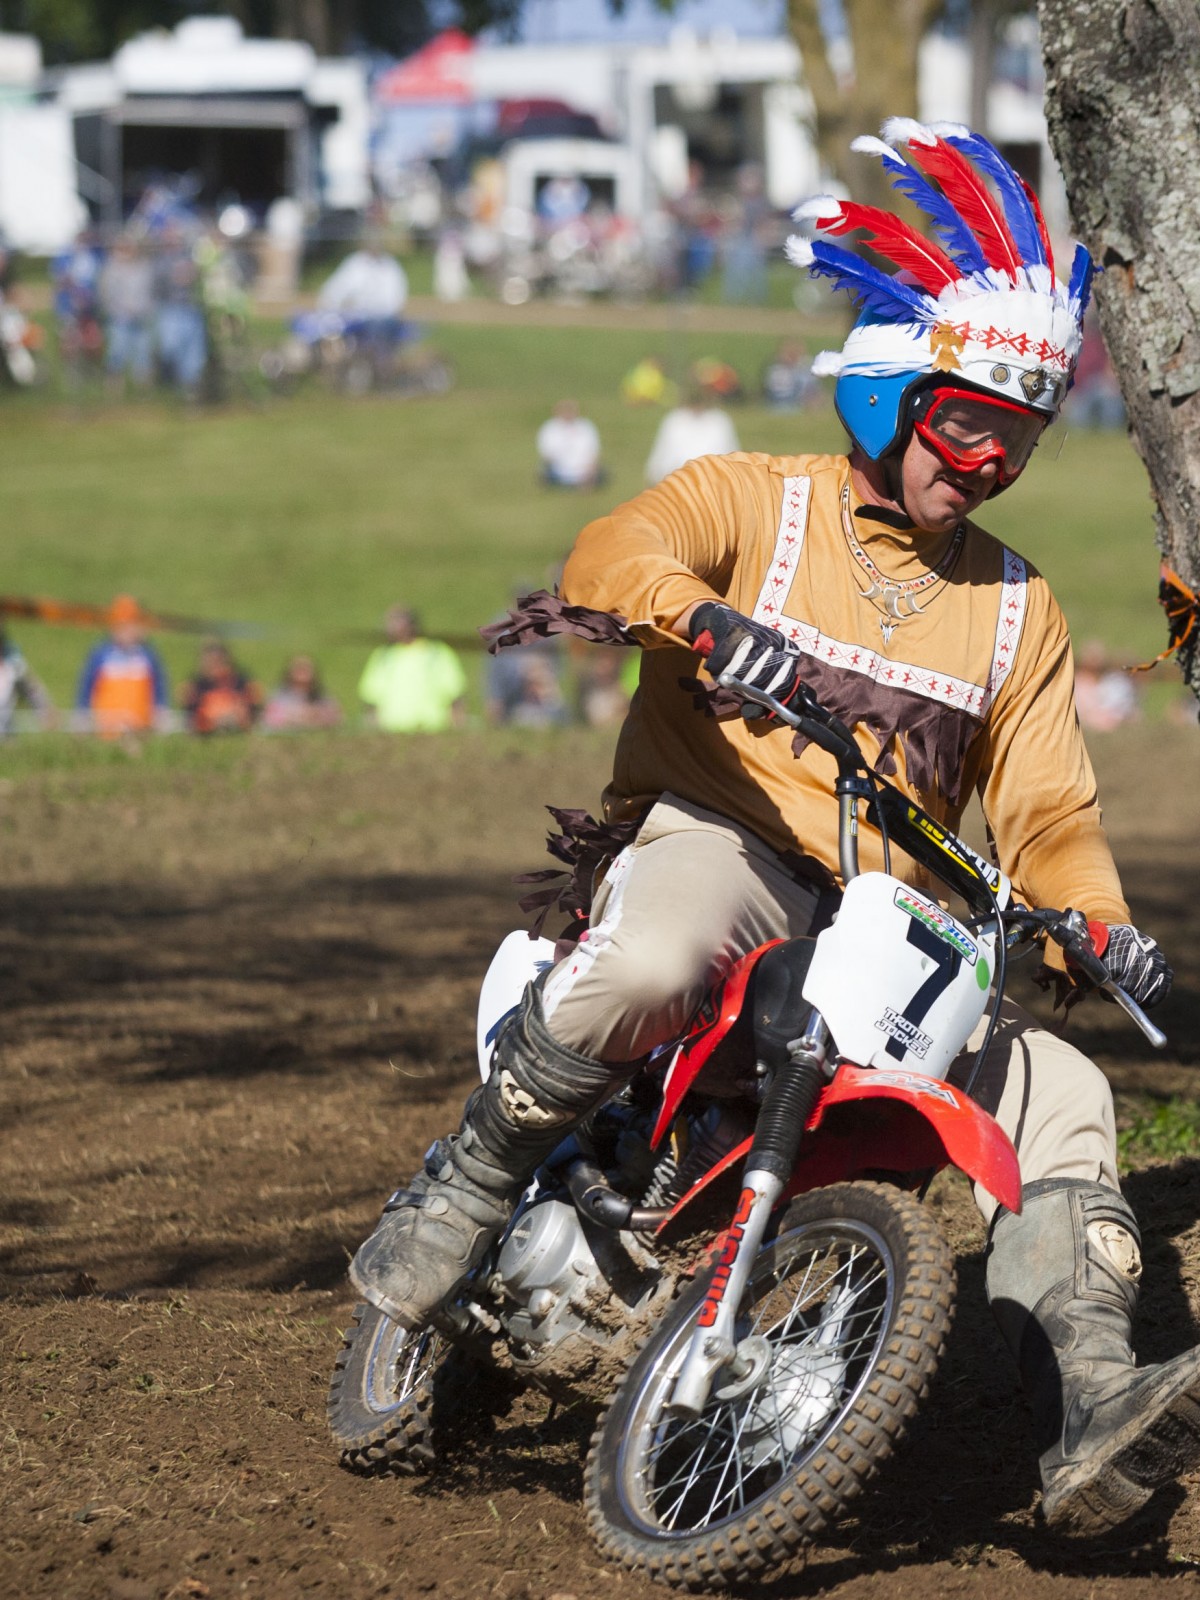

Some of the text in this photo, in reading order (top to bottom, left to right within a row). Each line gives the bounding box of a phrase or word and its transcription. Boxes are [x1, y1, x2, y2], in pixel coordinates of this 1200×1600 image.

[885, 914, 964, 1062] 7
[874, 1018, 928, 1060] JOCKEY
[884, 1006, 934, 1050] THROTTLE
